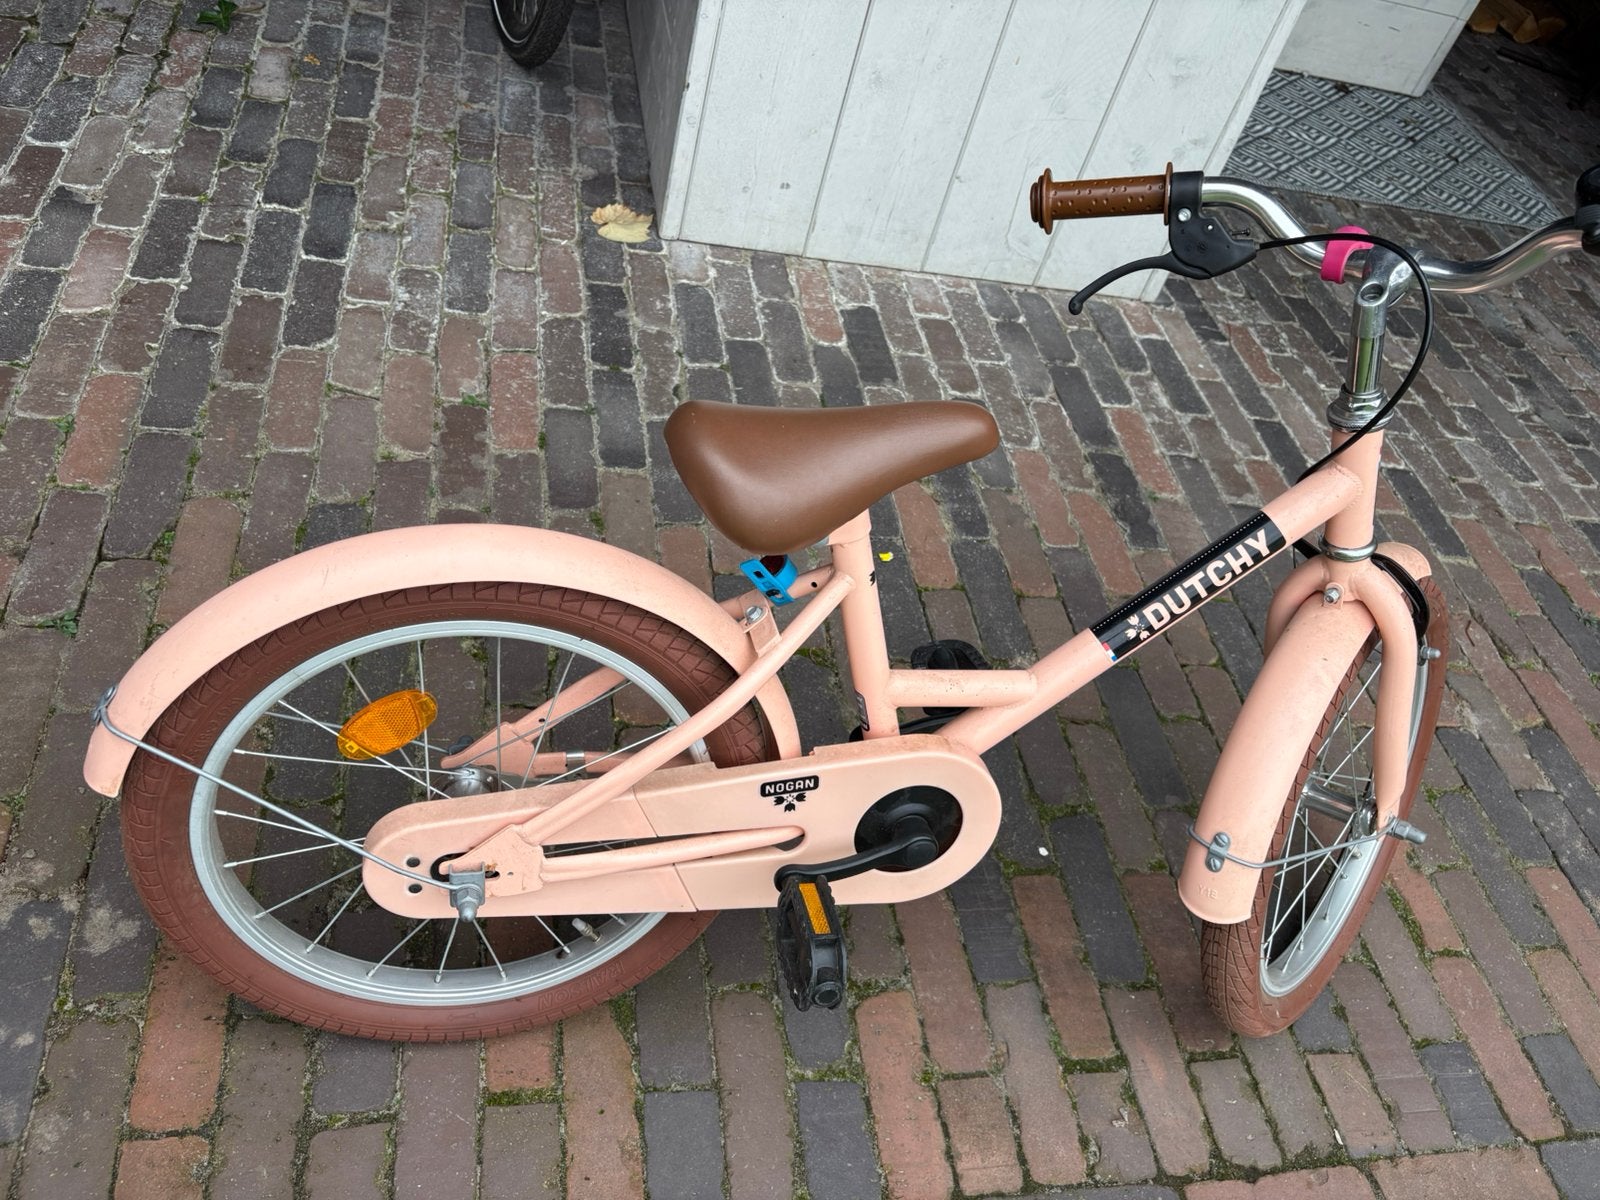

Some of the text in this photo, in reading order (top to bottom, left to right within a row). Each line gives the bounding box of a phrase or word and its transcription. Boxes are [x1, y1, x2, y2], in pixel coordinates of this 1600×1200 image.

[1143, 529, 1270, 630] DUTCHY
[765, 778, 815, 794] NOGAN
[538, 961, 624, 1011] RALSON
